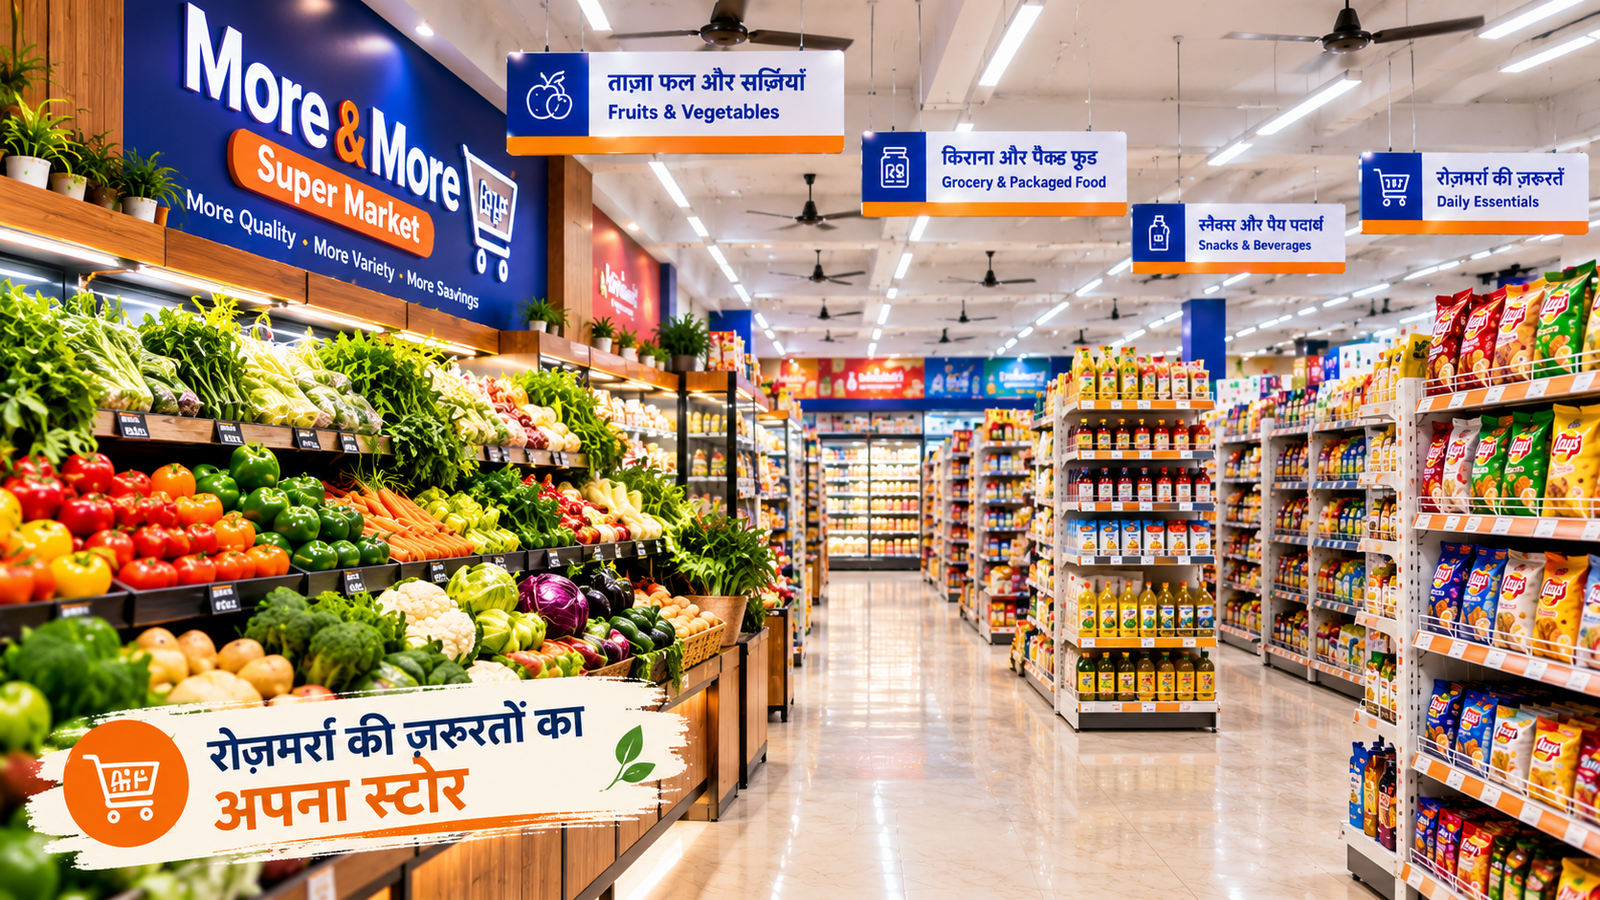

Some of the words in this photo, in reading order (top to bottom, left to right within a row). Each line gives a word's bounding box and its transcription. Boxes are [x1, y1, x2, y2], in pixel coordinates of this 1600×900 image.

[607, 74, 654, 94] ताज़ा
[658, 74, 697, 92] फल
[701, 67, 735, 92] और
[185, 2, 330, 149] More
[334, 100, 366, 169] &
[370, 106, 461, 213] More
[608, 103, 658, 120] Fruits
[663, 103, 677, 120] &
[681, 103, 780, 124] Vegetables
[941, 145, 995, 166] किराना
[999, 145, 1028, 166] और
[942, 175, 993, 191] Grocery
[997, 175, 1007, 189] &
[1010, 175, 1071, 191] Packaged
[1075, 175, 1106, 189] Food
[1492, 166, 1513, 186] की
[257, 144, 338, 208] Super
[344, 184, 420, 243] Market
[1437, 195, 1470, 210] Daily
[1474, 195, 1539, 208] Essentials
[1240, 214, 1263, 232] और
[187, 189, 234, 224] More
[240, 209, 296, 249] Quality
[314, 236, 349, 264] More
[352, 251, 395, 282] Variety
[407, 269, 434, 293] More
[1198, 239, 1239, 251] Snacks
[1241, 239, 1251, 251] &
[1253, 239, 1312, 253] Beverages
